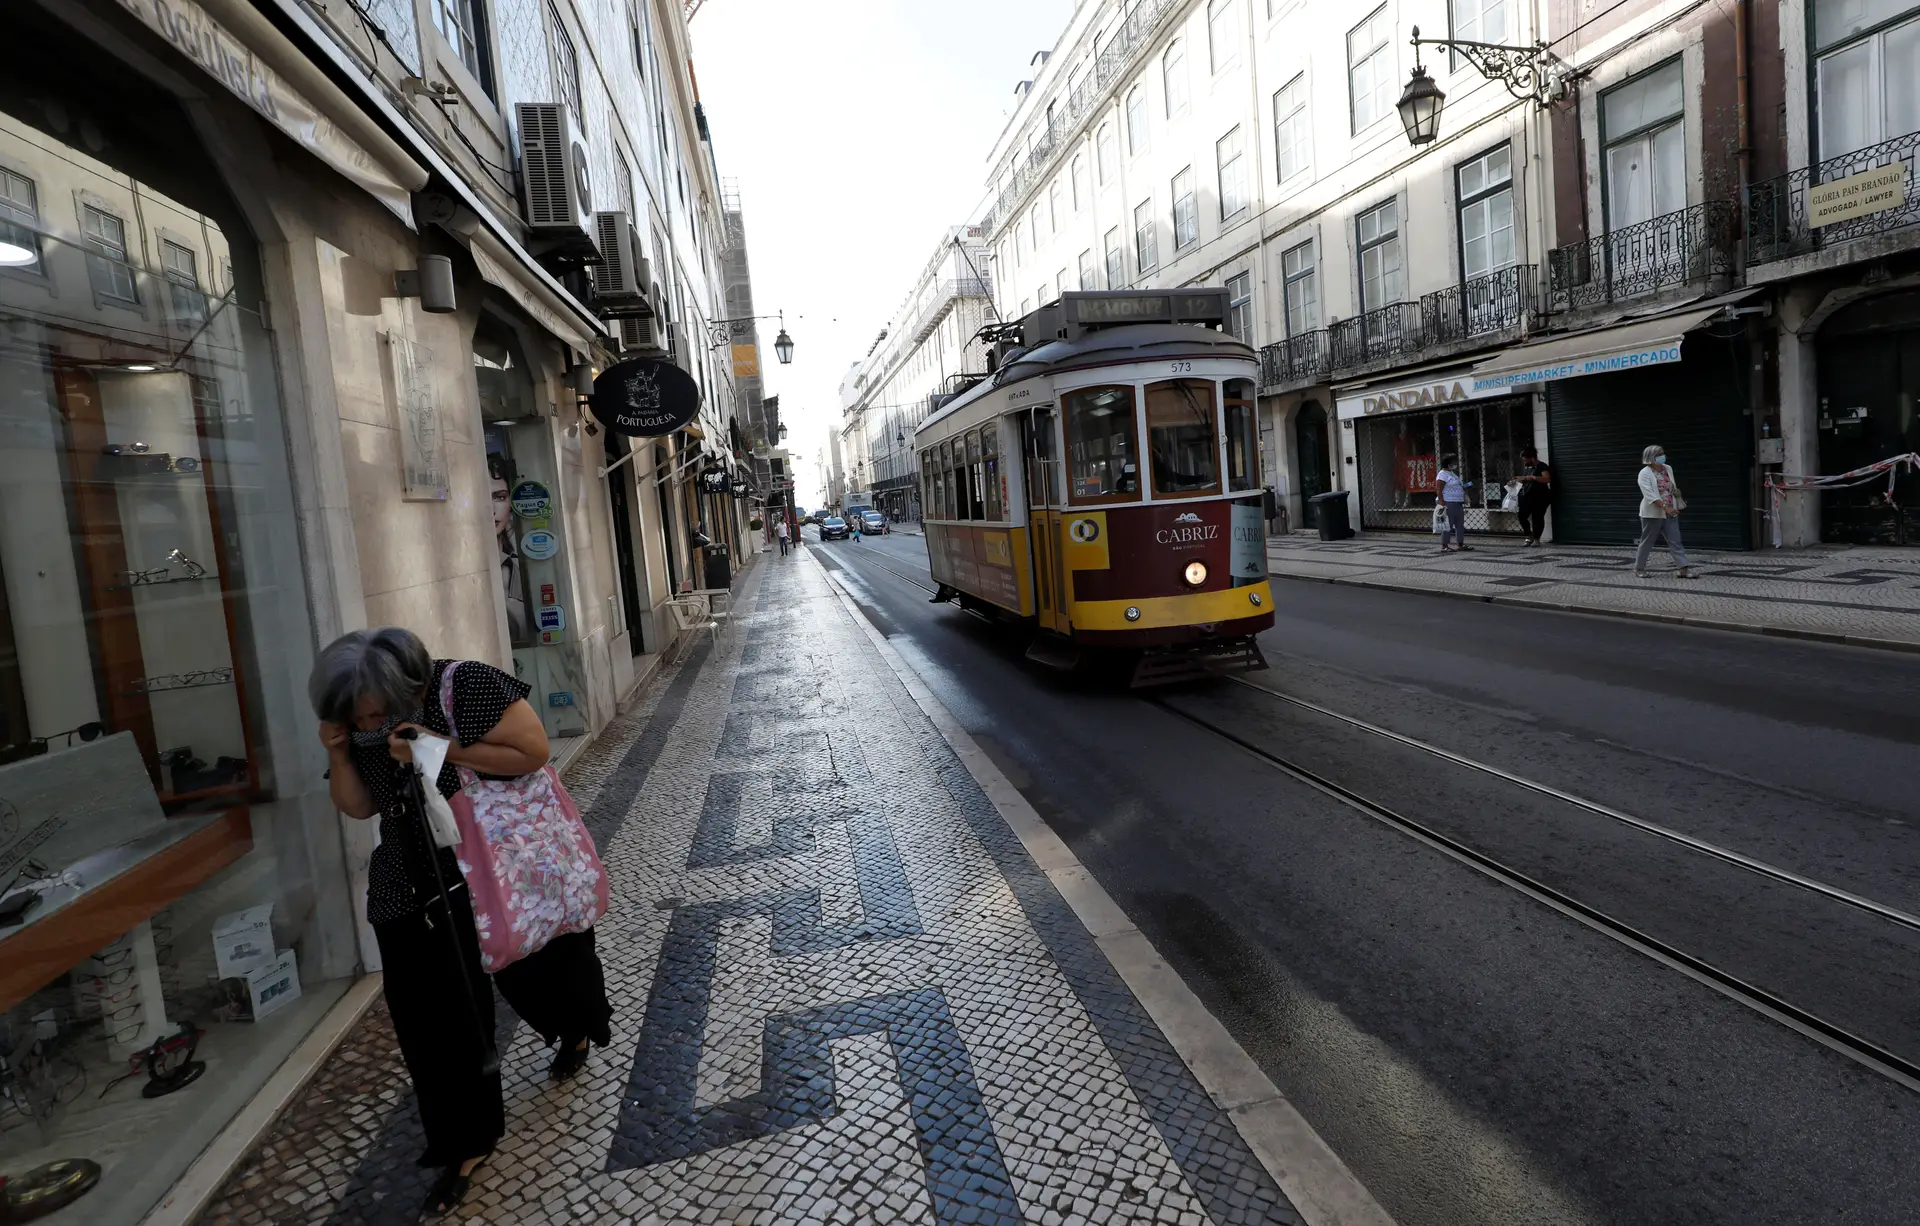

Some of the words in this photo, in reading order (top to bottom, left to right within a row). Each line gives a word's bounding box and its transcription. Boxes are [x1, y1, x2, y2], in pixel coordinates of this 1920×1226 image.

[1812, 191, 1840, 205] GLÓRIA
[1841, 185, 1860, 198] PAIS
[1861, 172, 1900, 192] BRANDÃO
[1818, 200, 1858, 217] ADVOGADA
[1865, 190, 1894, 205] LAWYER
[1185, 299, 1208, 314] 12
[1171, 362, 1192, 373] 573
[1474, 365, 1575, 391] MINISUPERMARKET
[1585, 347, 1680, 373] MINIMERCADO
[616, 412, 677, 427] PORTUGUESA
[1076, 488, 1086, 497] 01
[1156, 524, 1218, 544] CABRIZ
